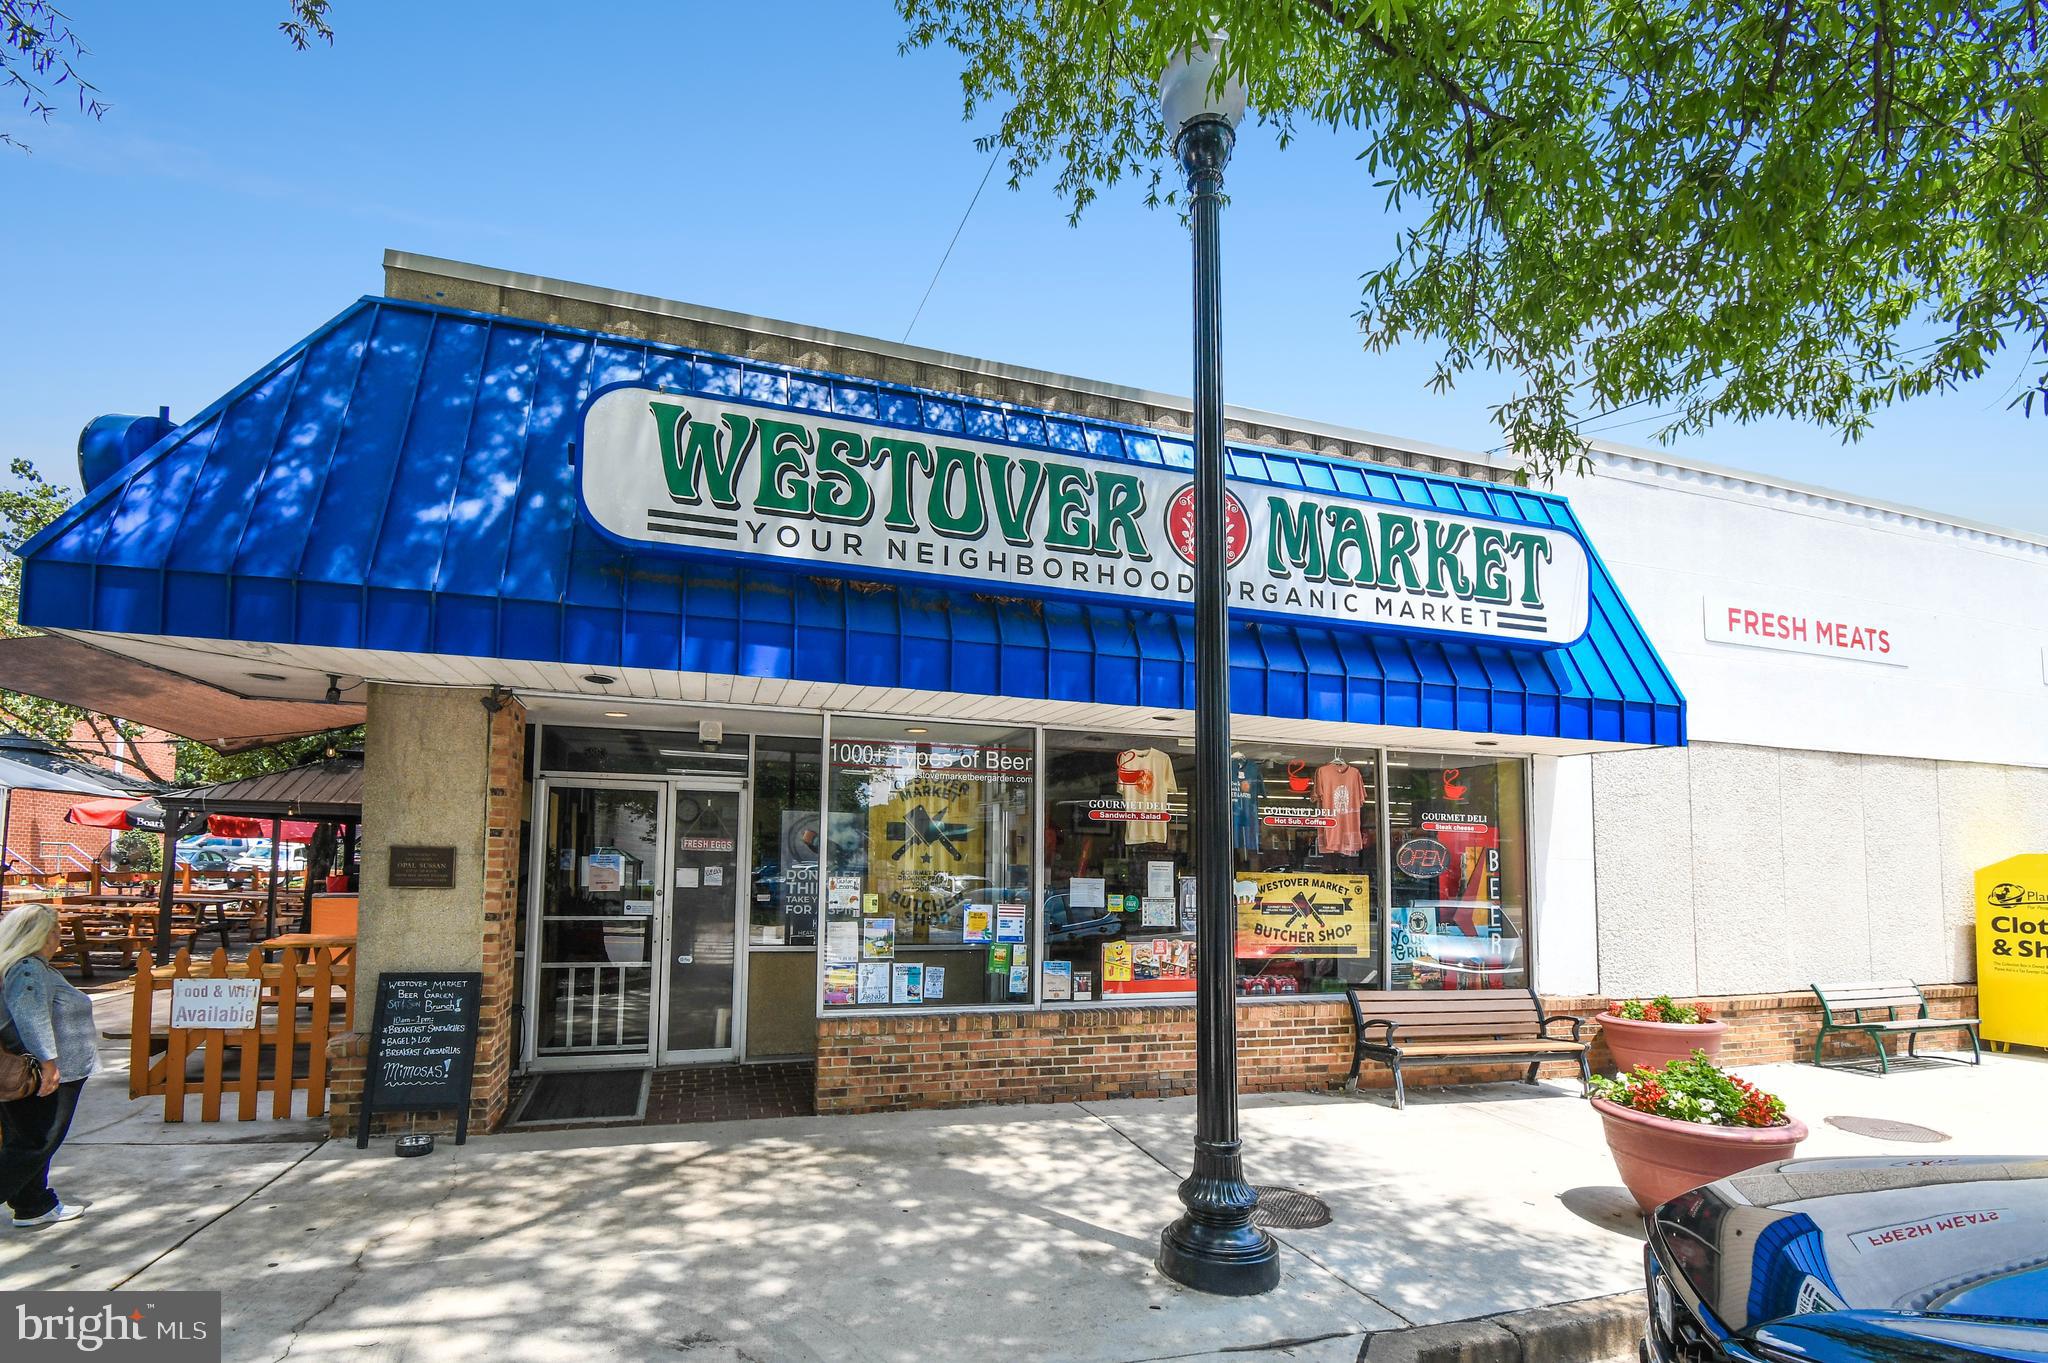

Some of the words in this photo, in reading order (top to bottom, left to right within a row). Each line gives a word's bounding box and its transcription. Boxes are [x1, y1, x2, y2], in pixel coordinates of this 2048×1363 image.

[648, 400, 1152, 563] WESTOVER
[1266, 495, 1552, 611] MARKET
[745, 519, 864, 557] YOUR
[887, 538, 1194, 594] NEIGHBORHOOD
[1226, 580, 1359, 613] RGANIC
[1375, 596, 1492, 628] MARKET
[1727, 607, 1807, 643] FRESH
[1816, 620, 1891, 654] MEATS
[829, 743, 884, 764] 1000+
[895, 748, 953, 769] Types
[960, 750, 980, 768] of
[985, 751, 1033, 770] Beer
[1088, 799, 1144, 810] GOURMET
[1099, 811, 1139, 820] Sandwich,
[1140, 812, 1162, 821] Salad
[1263, 806, 1314, 817] GOURMET
[1314, 808, 1338, 817] DELI
[1274, 817, 1287, 825] Hot
[1305, 818, 1327, 826] Coffee
[1421, 812, 1466, 822] GOURMET
[1467, 814, 1488, 823] DELI
[136, 816, 165, 831] Boar's
[1435, 823, 1453, 831] Steak
[1453, 824, 1475, 832] cheese
[683, 839, 709, 849] FRESH
[710, 840, 733, 850] EGGS
[1399, 847, 1447, 869] OPEN
[1257, 877, 1309, 895] WESTOVER
[1311, 878, 1350, 896] MARKET
[786, 896, 810, 904] TAKE
[2027, 890, 2048, 902] Pla
[785, 905, 812, 915] FOR
[1253, 922, 1315, 943] BUTCHER
[1318, 923, 1353, 942] SHOP
[1992, 938, 2013, 957] &
[432, 980, 468, 990] MARKET
[176, 985, 208, 998] Food
[213, 984, 223, 998] &
[398, 989, 419, 999] BEER
[423, 989, 454, 999] GARDEN
[175, 1005, 255, 1023] Available
[417, 1035, 432, 1044] LOX
